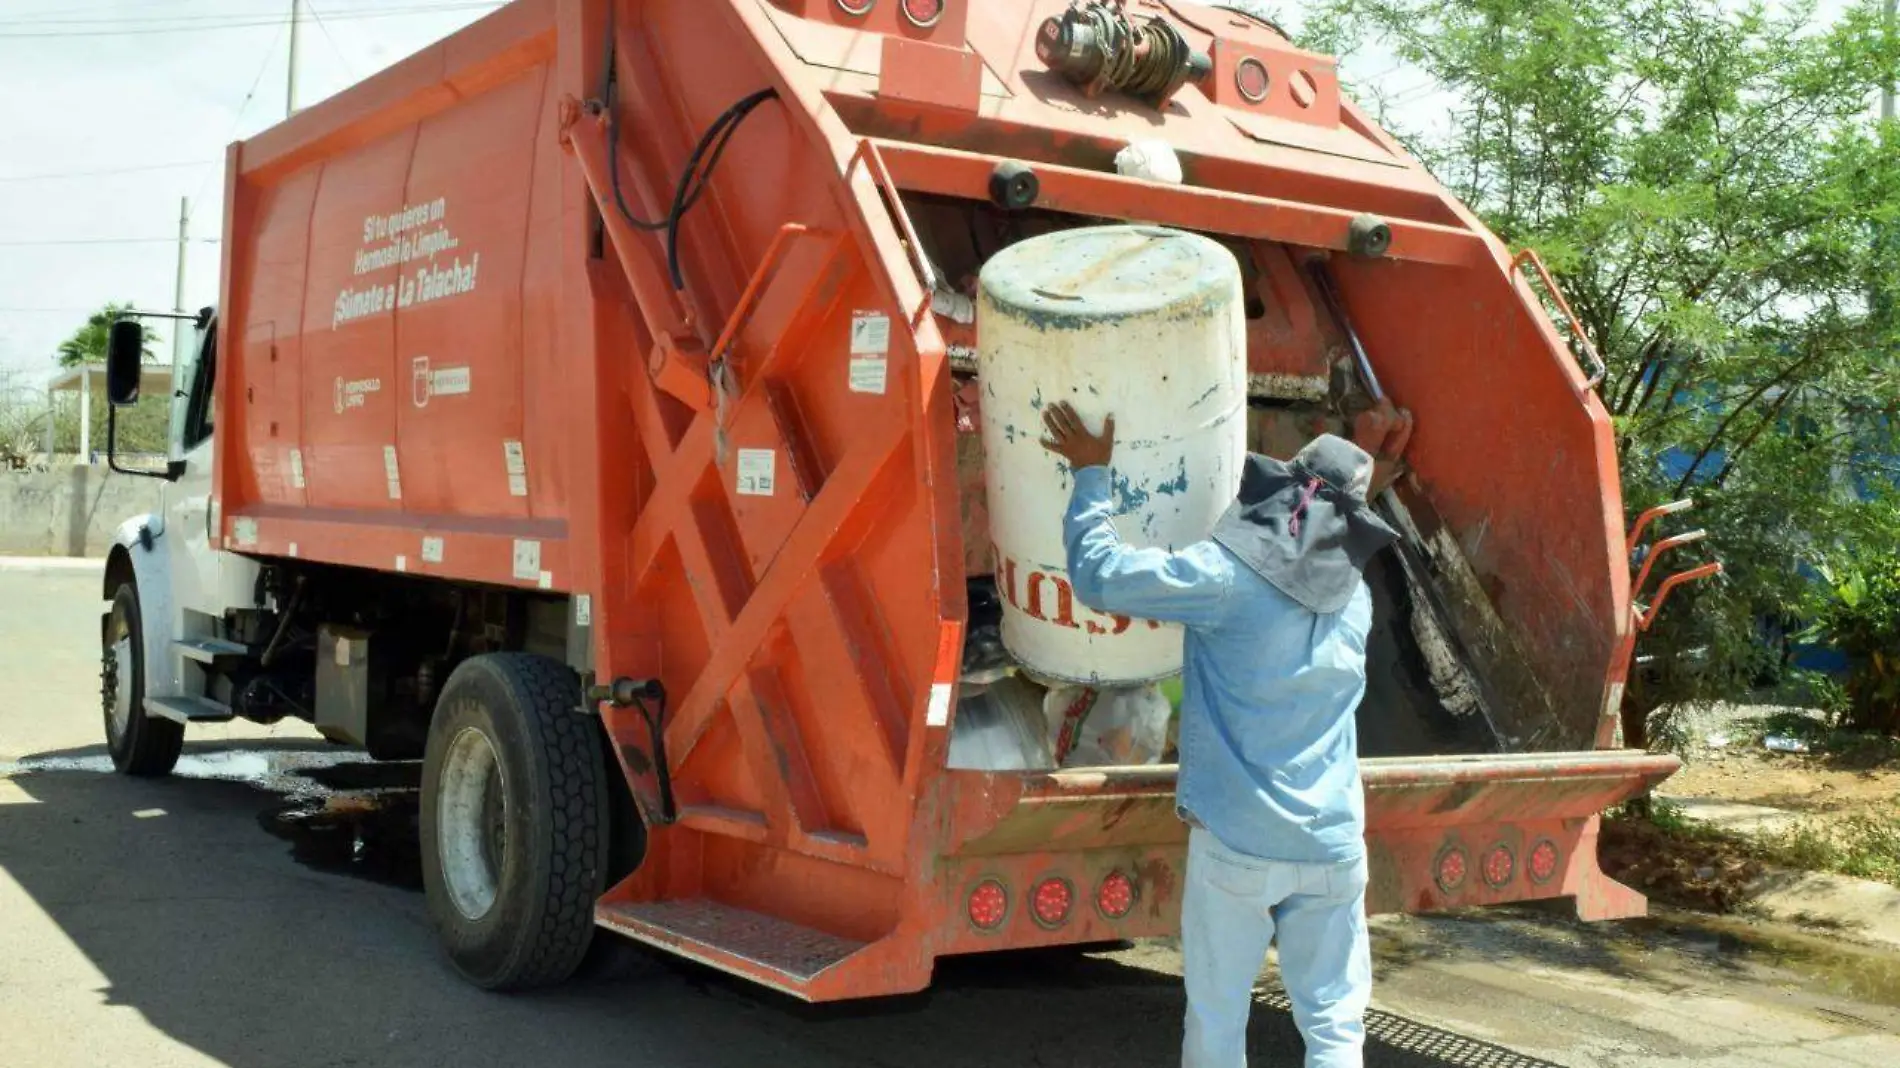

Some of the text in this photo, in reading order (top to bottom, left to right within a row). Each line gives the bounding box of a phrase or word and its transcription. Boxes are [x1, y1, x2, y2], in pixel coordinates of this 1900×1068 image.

[375, 214, 388, 240] tu
[388, 204, 429, 243] quieres
[430, 196, 445, 222] un
[385, 283, 396, 310] a
[397, 274, 416, 308] La
[416, 252, 479, 302] Talacha!
